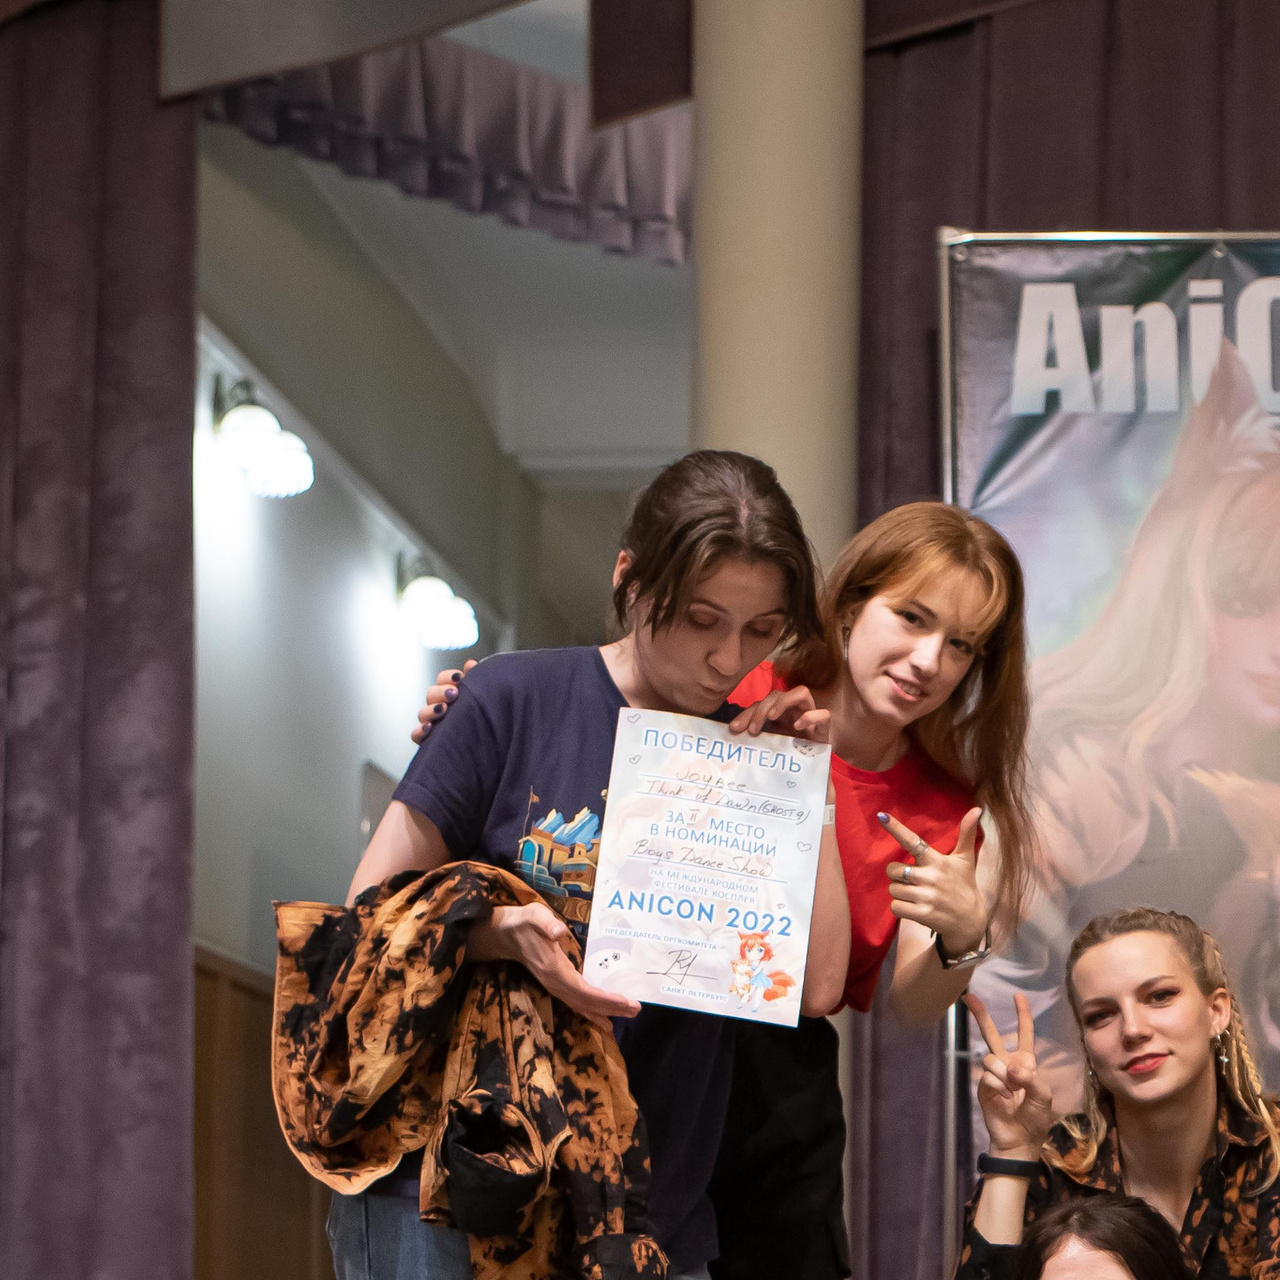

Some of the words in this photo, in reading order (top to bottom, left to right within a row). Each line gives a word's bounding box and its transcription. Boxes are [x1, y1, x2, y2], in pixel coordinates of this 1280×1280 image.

[643, 729, 802, 773] ПОБЕДИТЕЛЬ
[650, 823, 659, 836] В
[665, 825, 777, 857] НОМИНАЦИИ
[665, 810, 685, 825] ЗА
[709, 817, 765, 839] МЕСТО
[633, 839, 674, 864] Boys
[680, 846, 724, 869] Dance
[728, 856, 773, 878] Show
[650, 867, 664, 876] НА
[667, 869, 759, 893] МЕЖДУНАРОДНОМ
[653, 879, 709, 897] ФЕСТИВАЛЕ
[712, 890, 755, 904] КОСПЛЕЯ
[607, 889, 715, 924] ANICON
[726, 907, 792, 937] 2022
[605, 927, 662, 941] ПРЕДСЕДАТЕЛЬ
[663, 936, 718, 950] ОРГКОМИТЕТА
